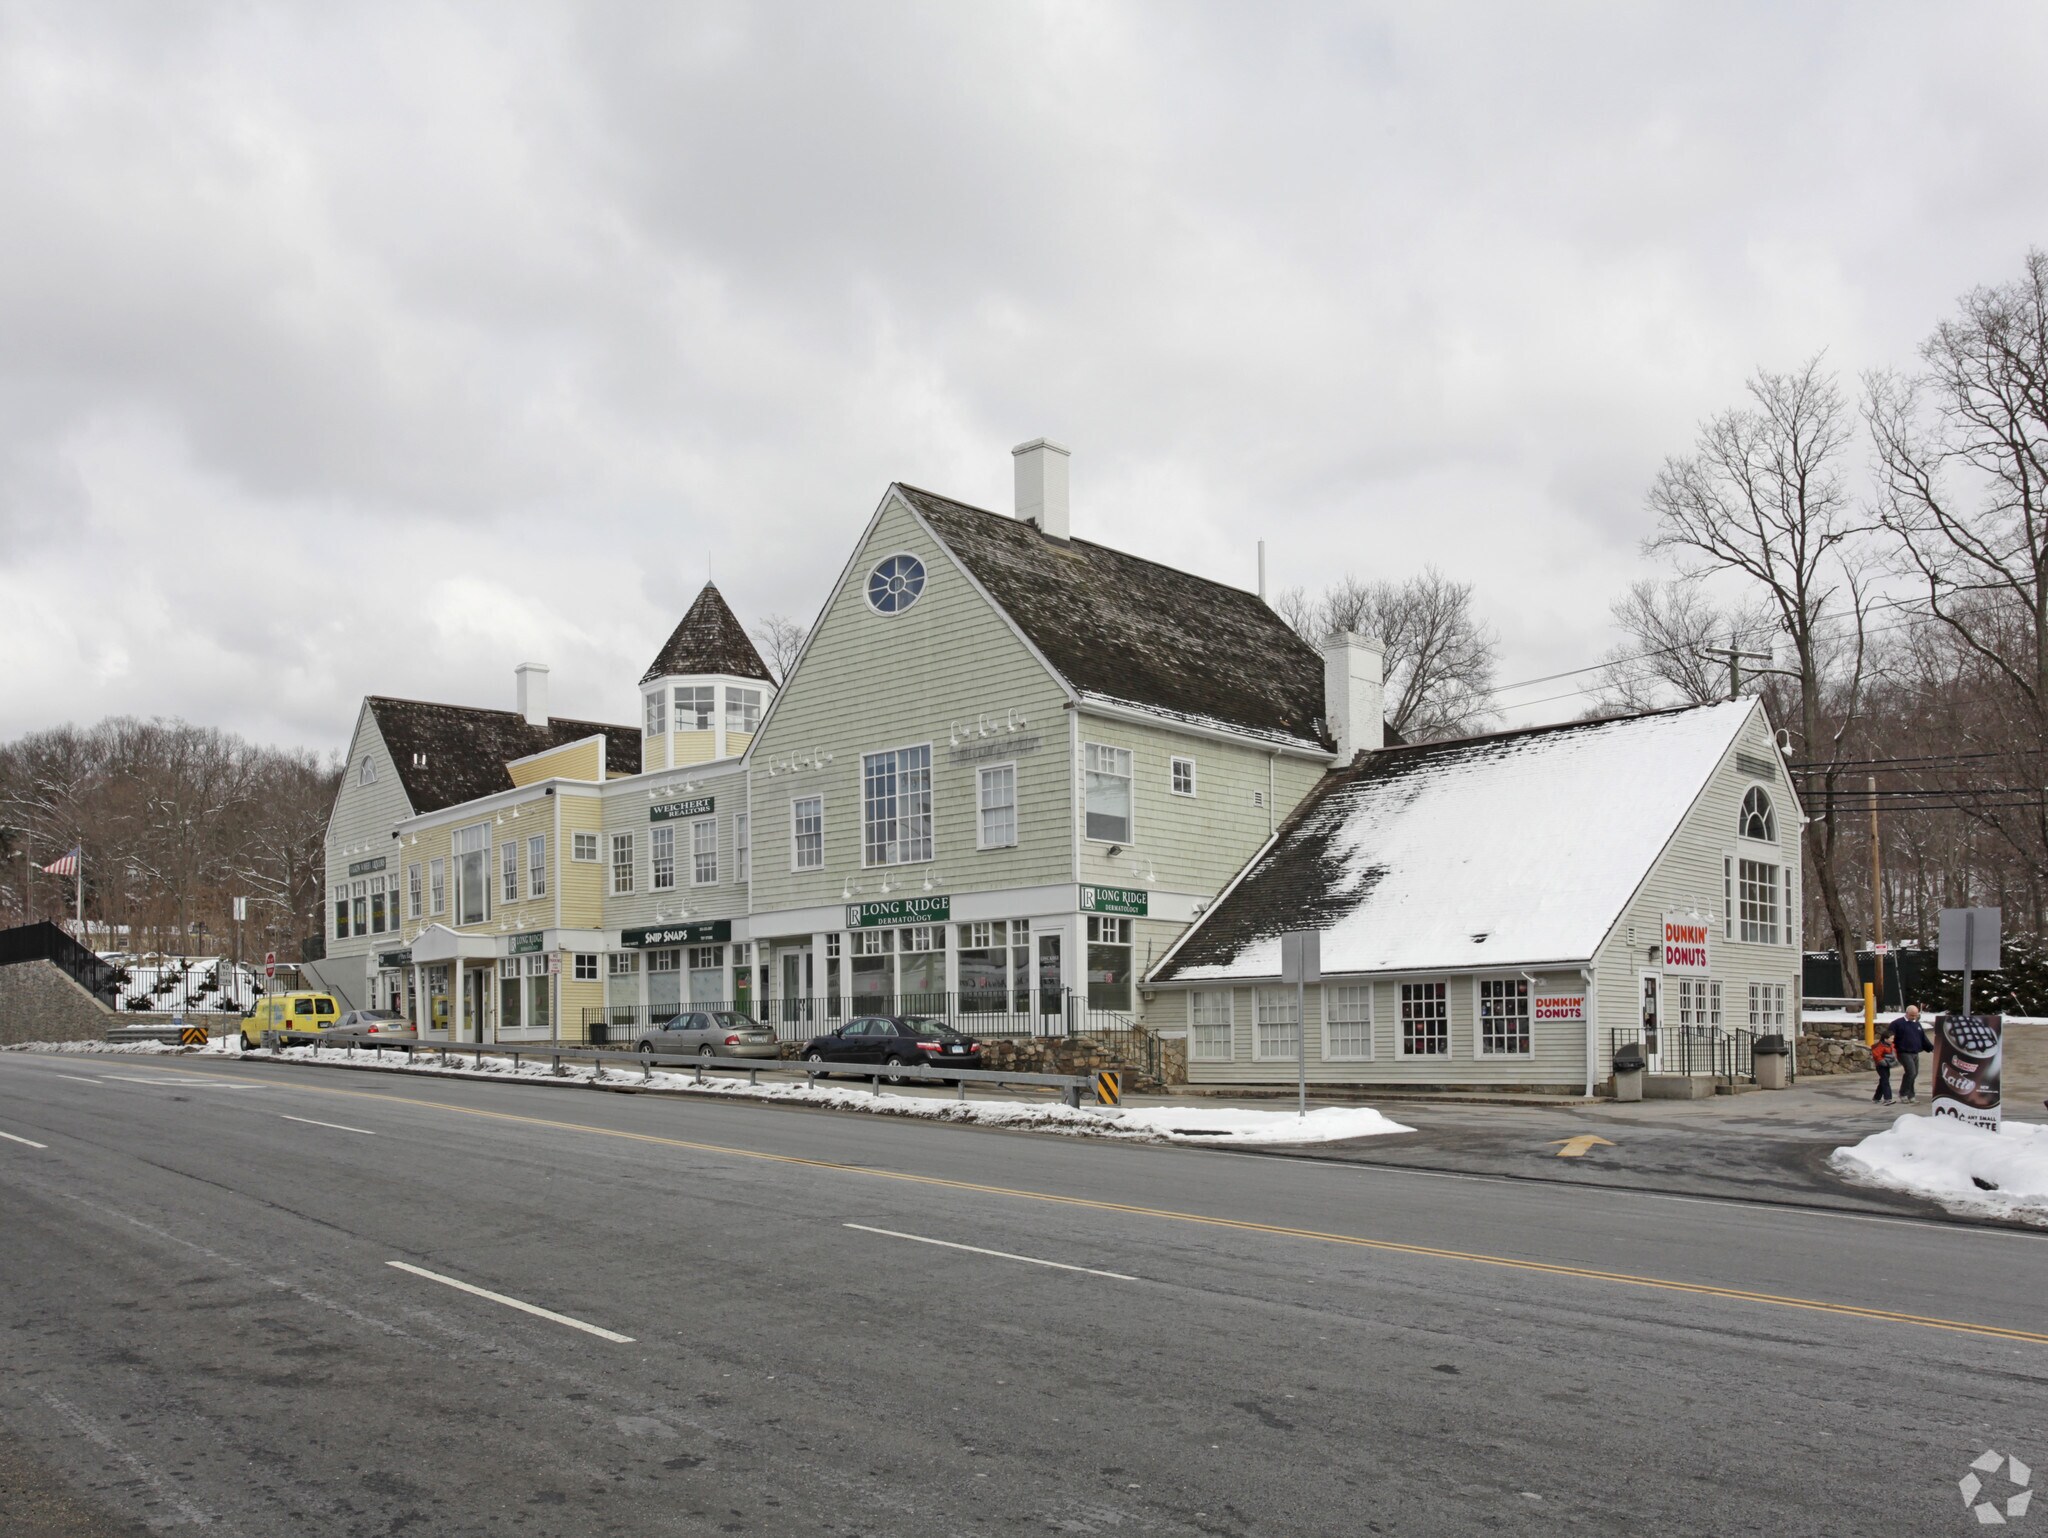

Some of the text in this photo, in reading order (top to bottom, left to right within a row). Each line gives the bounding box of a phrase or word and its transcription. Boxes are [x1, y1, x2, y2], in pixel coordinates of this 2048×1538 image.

[653, 799, 710, 813] WEICHERT
[669, 805, 710, 817] REALTORS
[1097, 889, 1119, 902] LONG
[1122, 891, 1147, 906] RIDGE
[862, 901, 899, 916] LONG
[905, 897, 949, 916] RIDGE
[1105, 904, 1139, 913] DERMATOLOGY
[878, 914, 932, 925] DERMATOLOGY
[645, 929, 688, 944] SNIP SNAPS
[1665, 923, 1708, 944] DUNKIN'
[1666, 946, 1707, 967] DONUTS
[1536, 997, 1584, 1008] DUNKIN'
[1536, 1008, 1582, 1019] DONUTS
